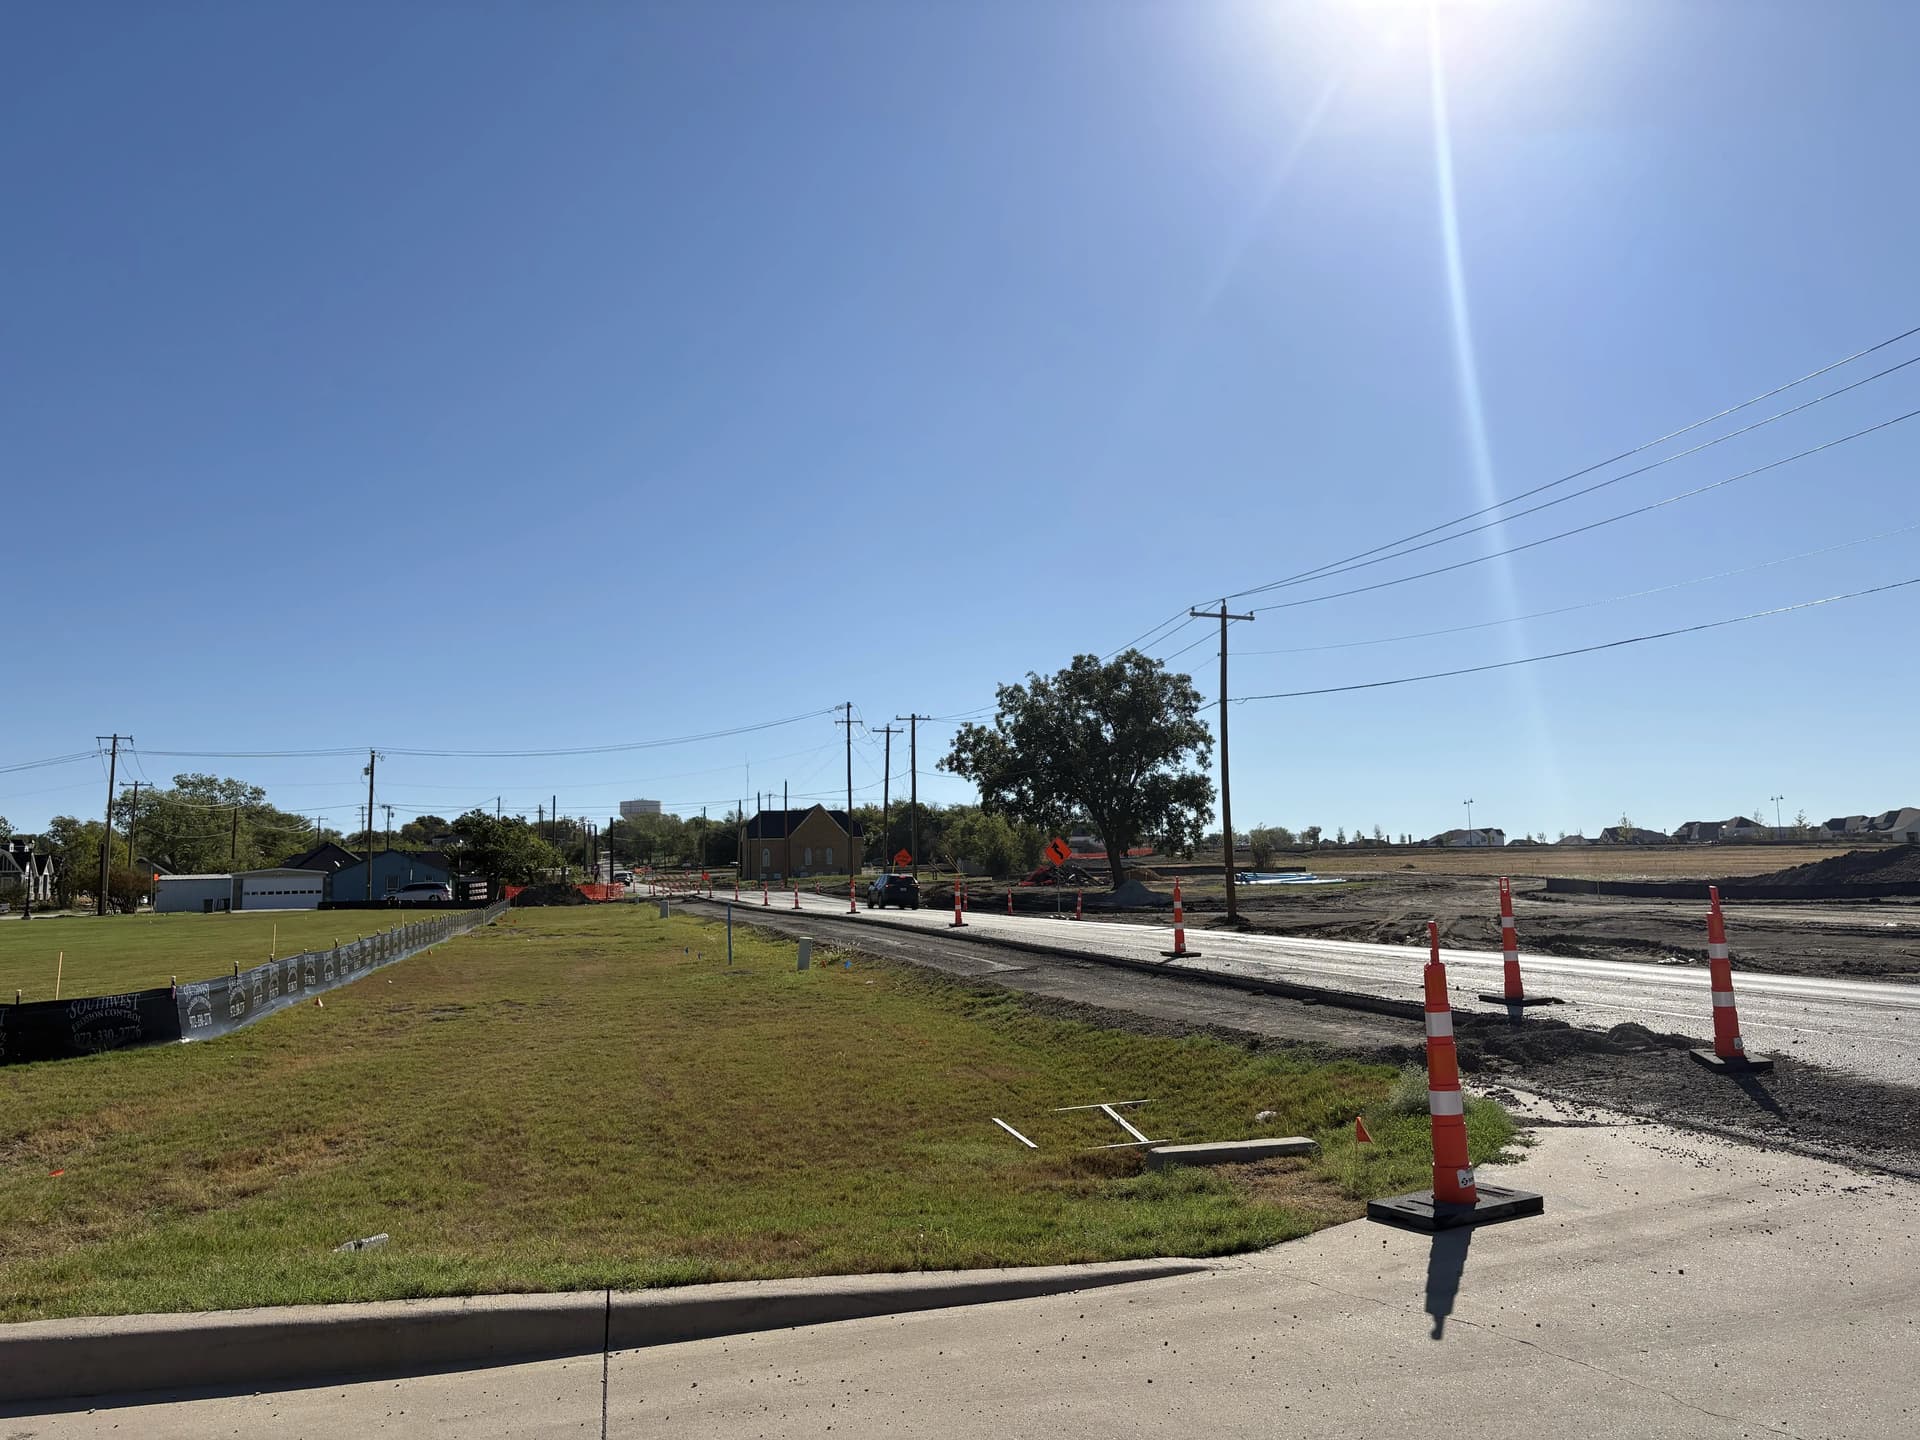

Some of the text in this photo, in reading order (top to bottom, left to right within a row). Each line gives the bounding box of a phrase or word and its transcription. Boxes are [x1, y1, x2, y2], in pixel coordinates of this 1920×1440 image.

[67, 994, 141, 1018] SOUTHWEST
[71, 1008, 141, 1032] EROSION CONTROL
